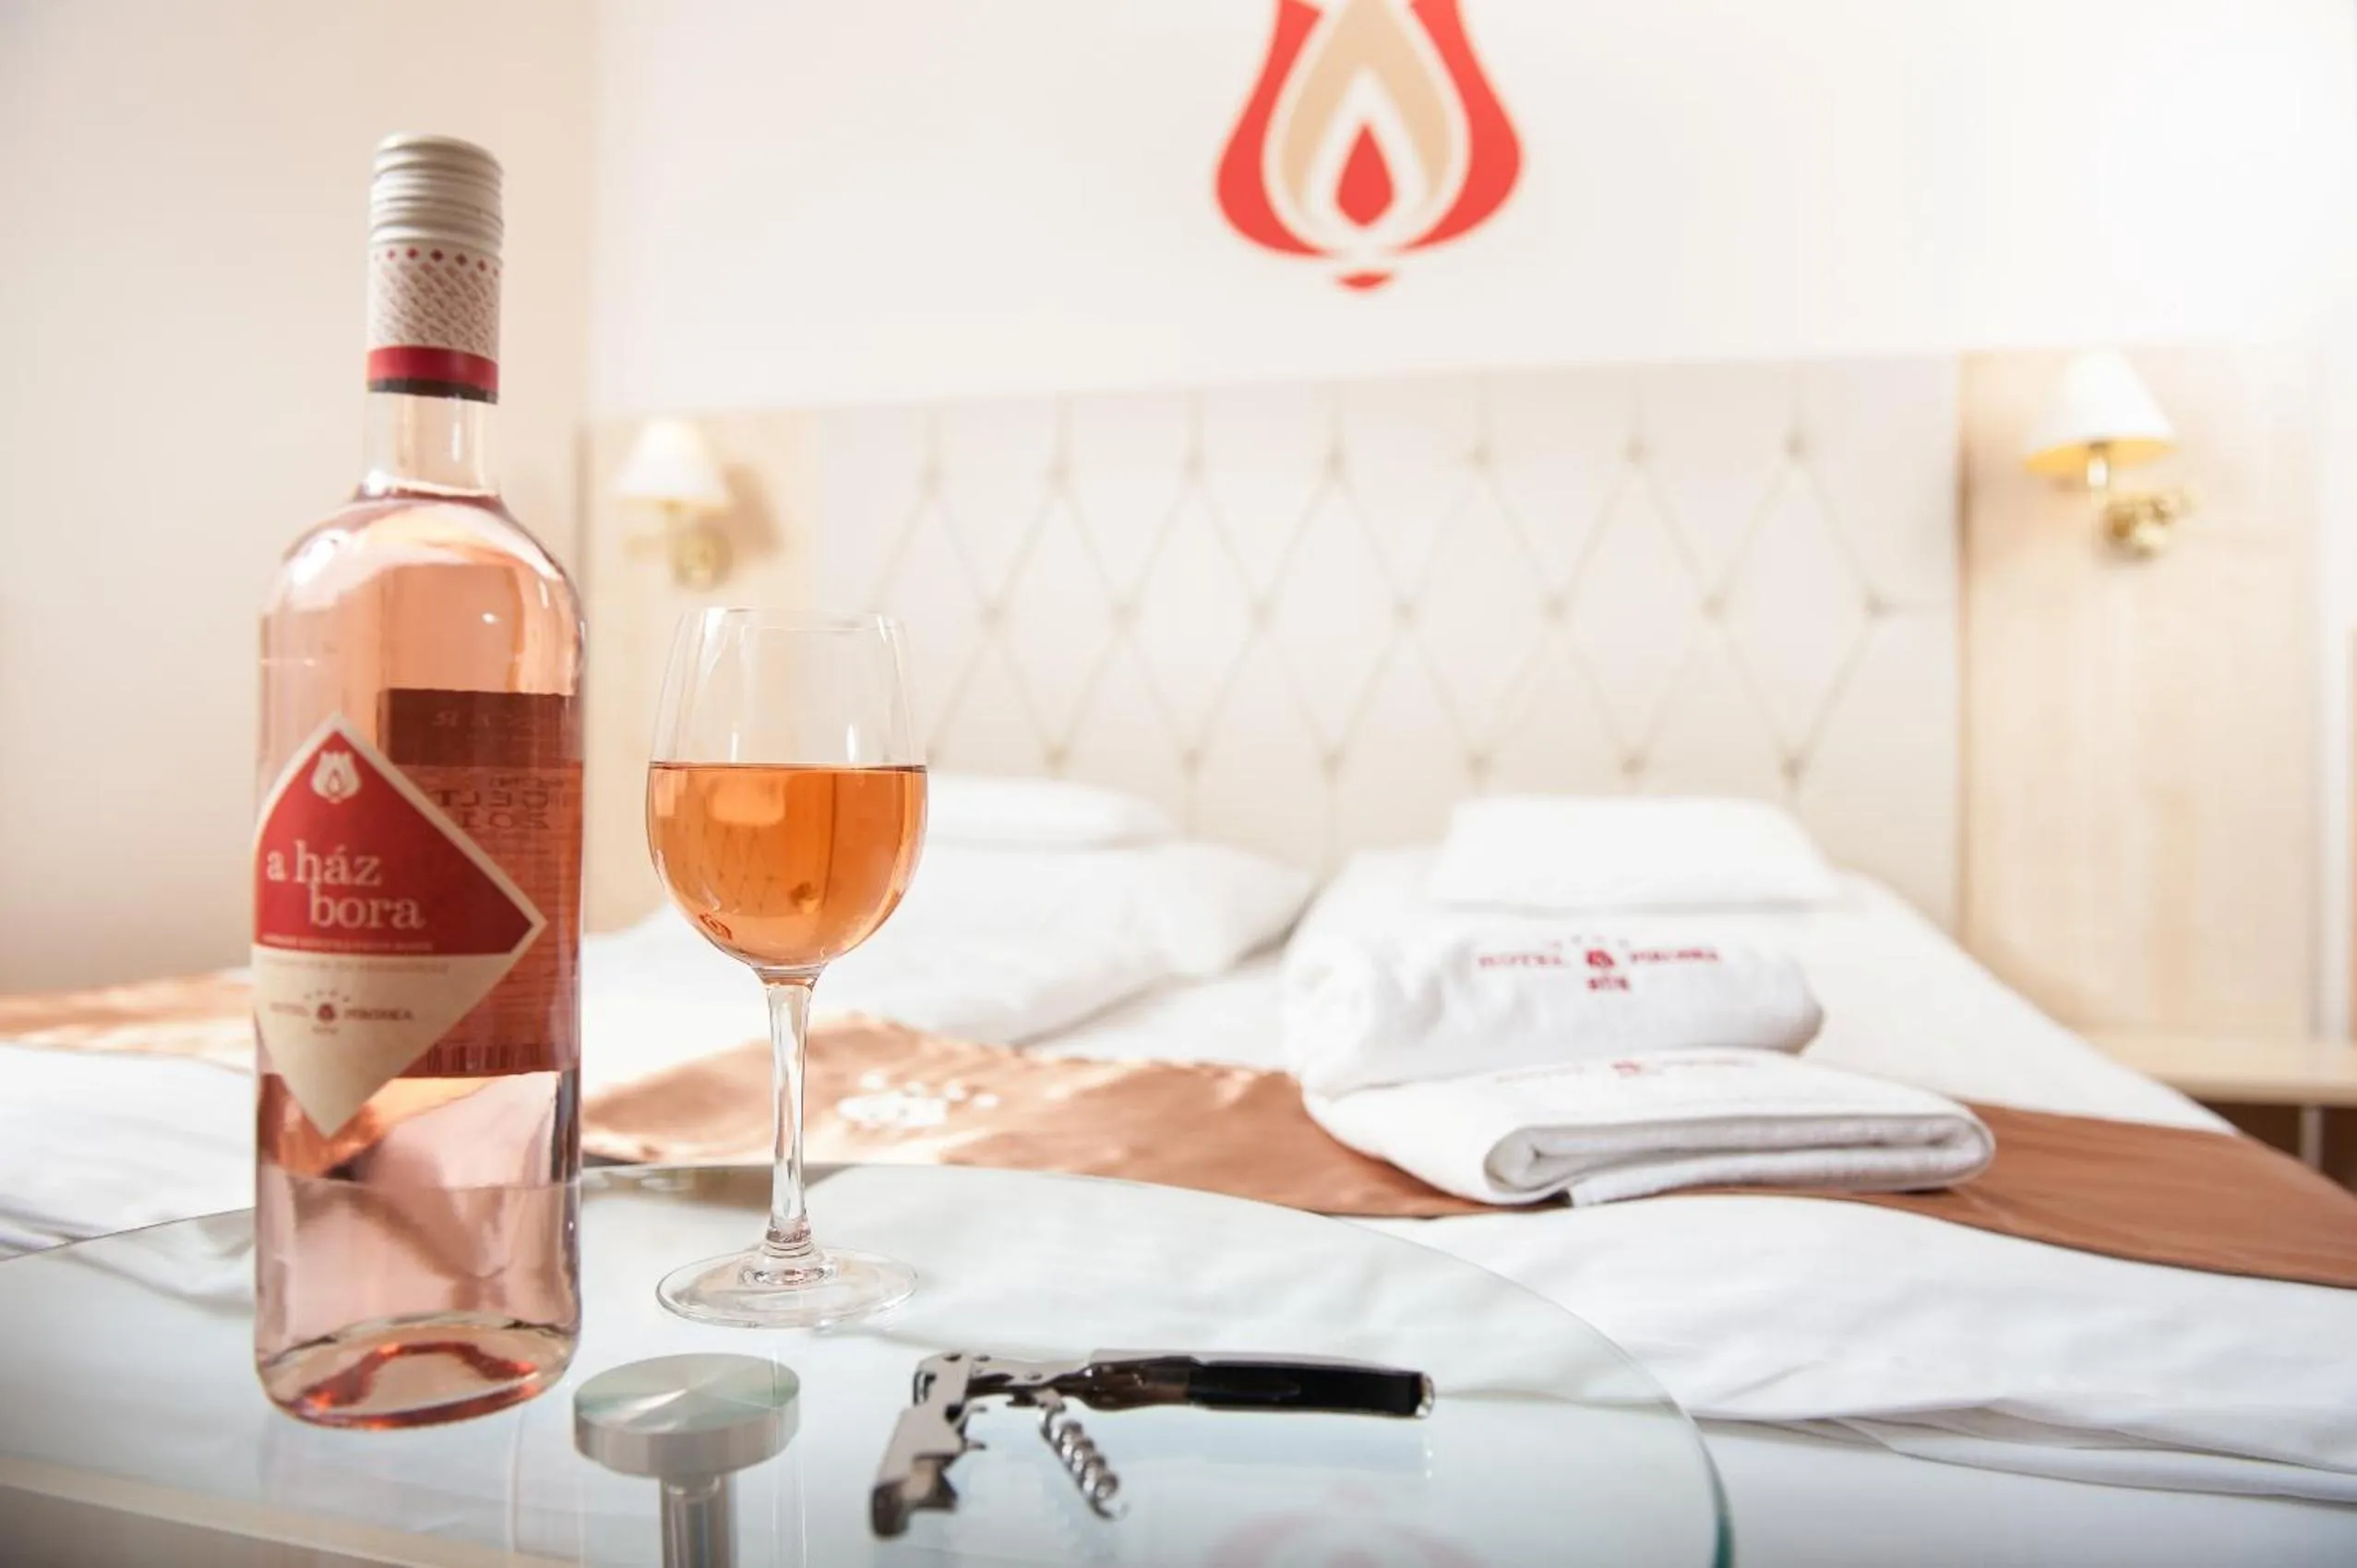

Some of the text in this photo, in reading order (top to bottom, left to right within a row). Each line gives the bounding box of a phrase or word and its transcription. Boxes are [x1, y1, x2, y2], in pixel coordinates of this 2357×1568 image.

[266, 838, 383, 887] a ház
[308, 881, 427, 929] bora
